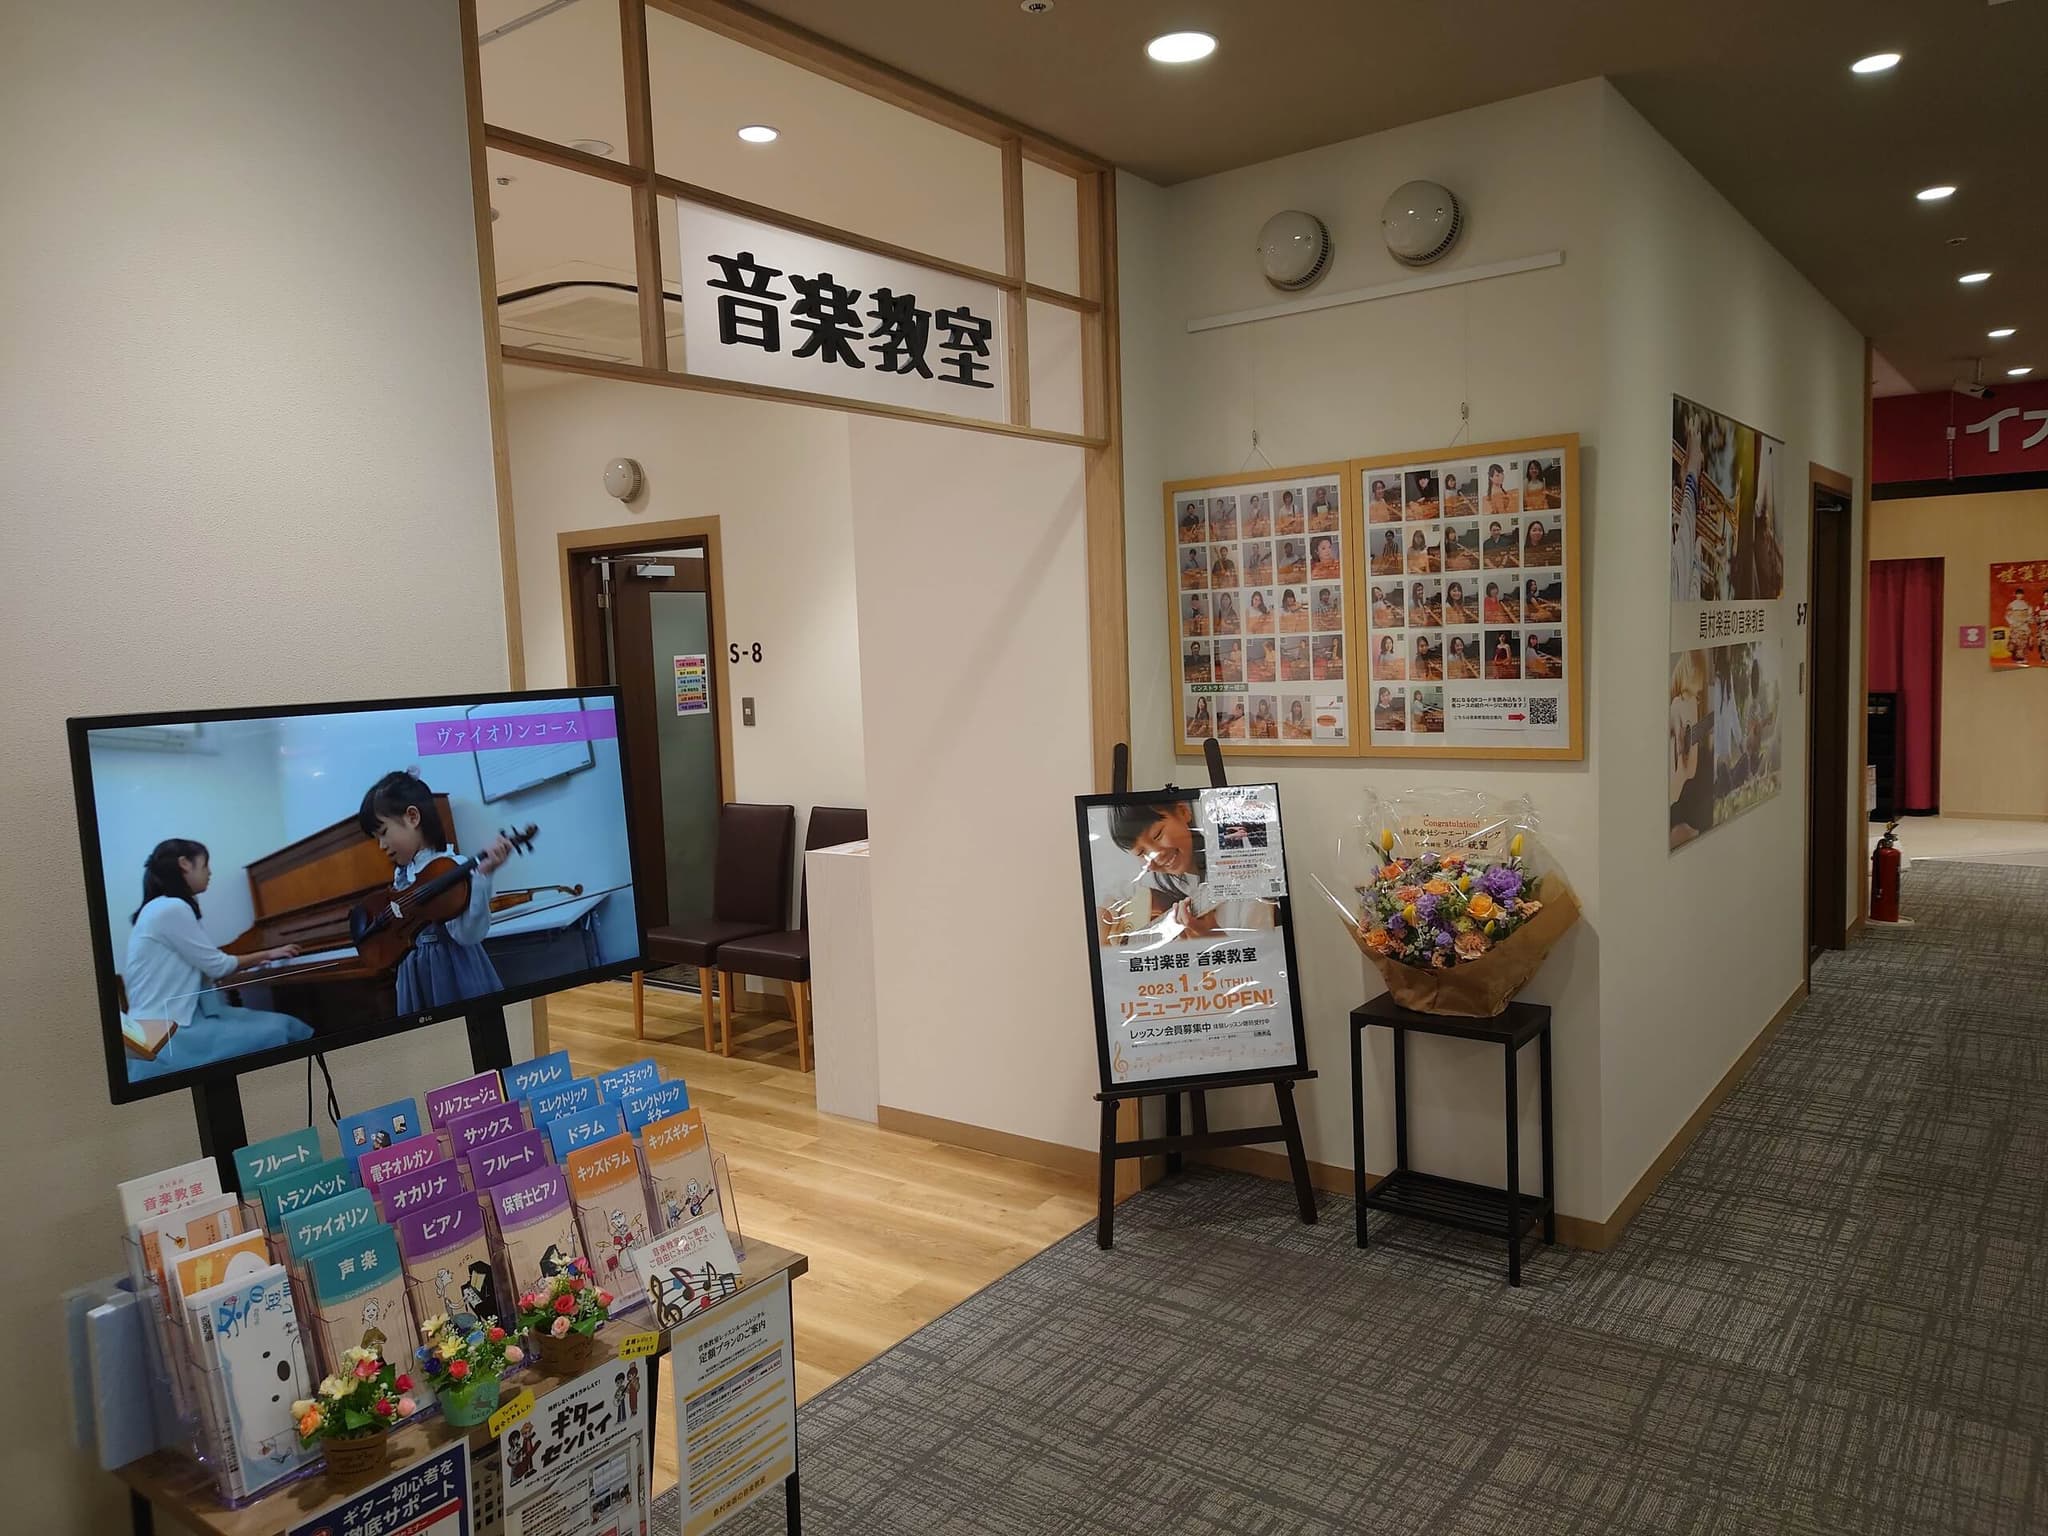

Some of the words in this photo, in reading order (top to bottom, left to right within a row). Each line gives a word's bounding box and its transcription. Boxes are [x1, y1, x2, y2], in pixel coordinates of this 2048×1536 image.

[707, 251, 994, 389] 音楽教室
[1699, 609, 1765, 639] 島村楽器の音楽教室
[730, 642, 762, 664] S-8
[436, 720, 578, 748] ヴァイオリンコース
[1129, 953, 1190, 972] 島村楽器
[1196, 947, 1257, 966] 音楽教室
[1130, 1022, 1212, 1040] レッスン会員募集中
[516, 1065, 562, 1090] ウクレレ
[603, 1064, 653, 1092] アコースティック
[434, 1087, 497, 1118] ソルフェージュ
[539, 1087, 588, 1114] エレクトリック
[631, 1087, 680, 1114] エレクトリック
[464, 1116, 513, 1145] サックス
[567, 1122, 605, 1144] ドラム
[648, 1122, 699, 1150] キッズギター
[250, 1145, 310, 1178] フルート
[370, 1148, 433, 1182] 電子オルガン
[482, 1146, 534, 1177] フルート
[577, 1150, 631, 1182] キッズドラム
[144, 1181, 204, 1212] 音楽教室
[277, 1175, 346, 1213] トランペット
[394, 1176, 447, 1209] オカリナ
[502, 1180, 557, 1216] 保育士ピアノ
[299, 1207, 368, 1245] ヴァイオリン
[423, 1209, 462, 1240] ピアノ
[338, 1249, 378, 1280] 声楽
[551, 1401, 604, 1439] ギター
[541, 1413, 612, 1468] センパイ
[343, 1459, 453, 1527] ギター初心者を
